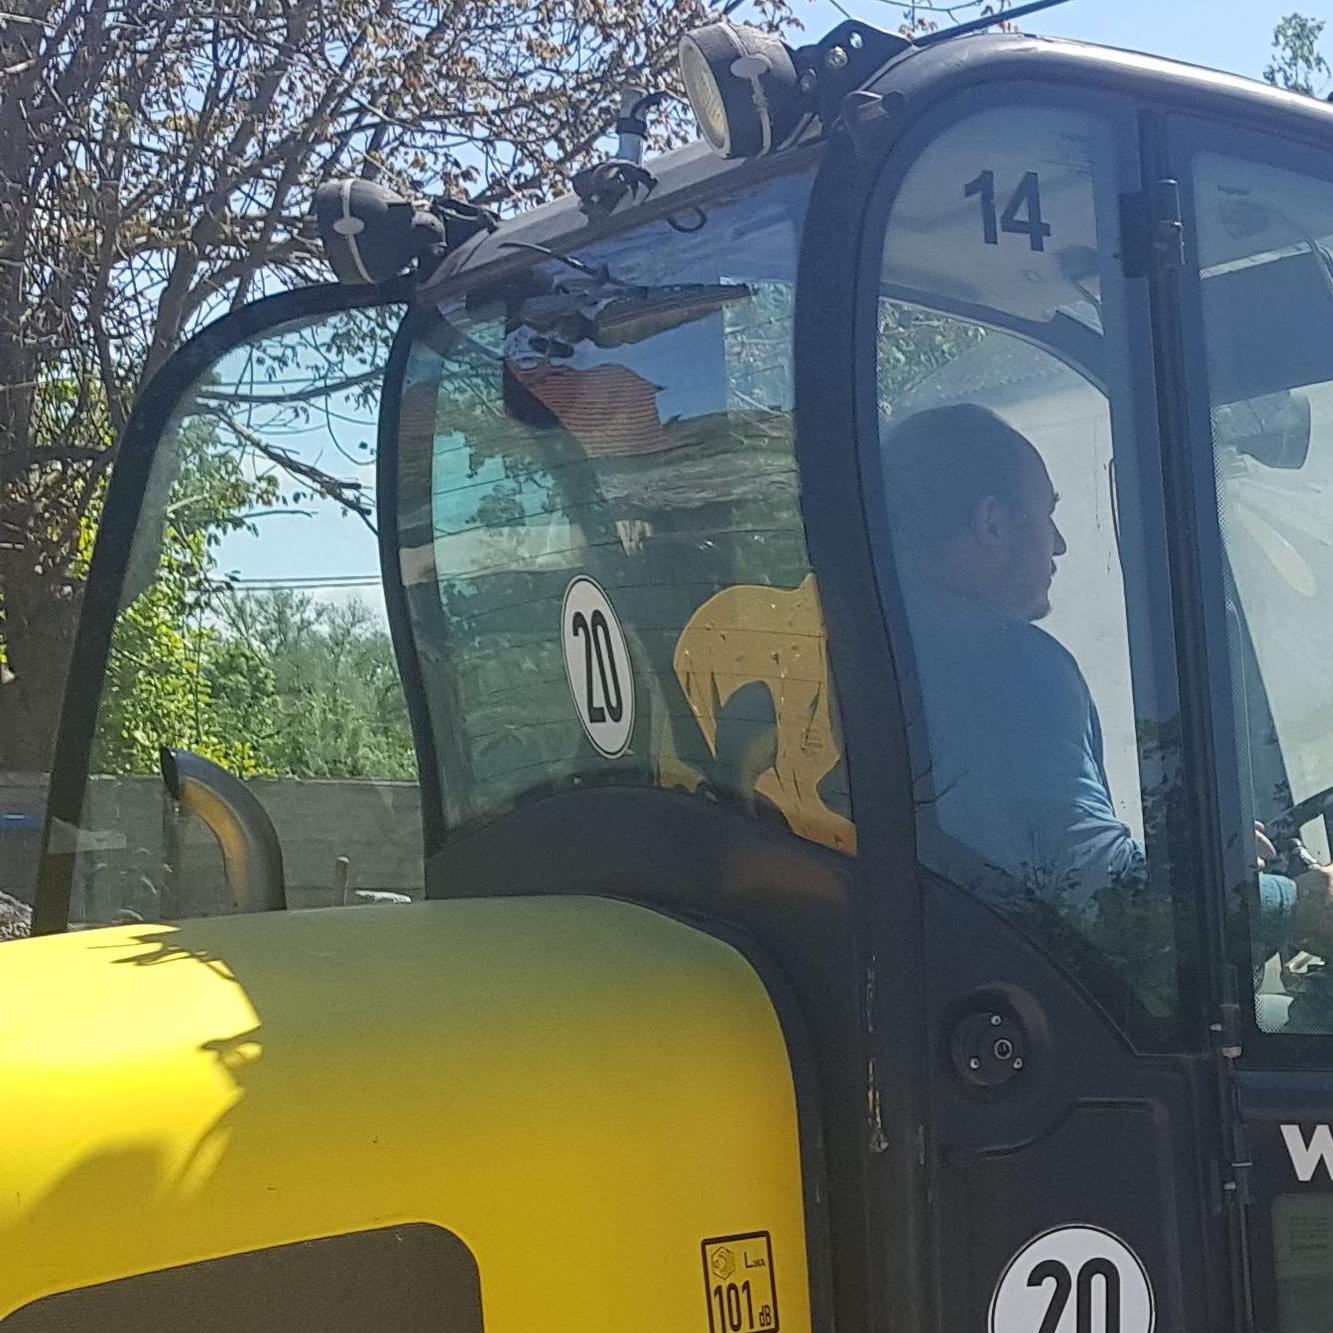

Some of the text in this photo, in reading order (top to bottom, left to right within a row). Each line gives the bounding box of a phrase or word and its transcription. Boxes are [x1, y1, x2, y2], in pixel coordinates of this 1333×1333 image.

[964, 169, 1051, 252] 14
[573, 609, 623, 723] 20
[714, 1280, 772, 1333] 101 dB
